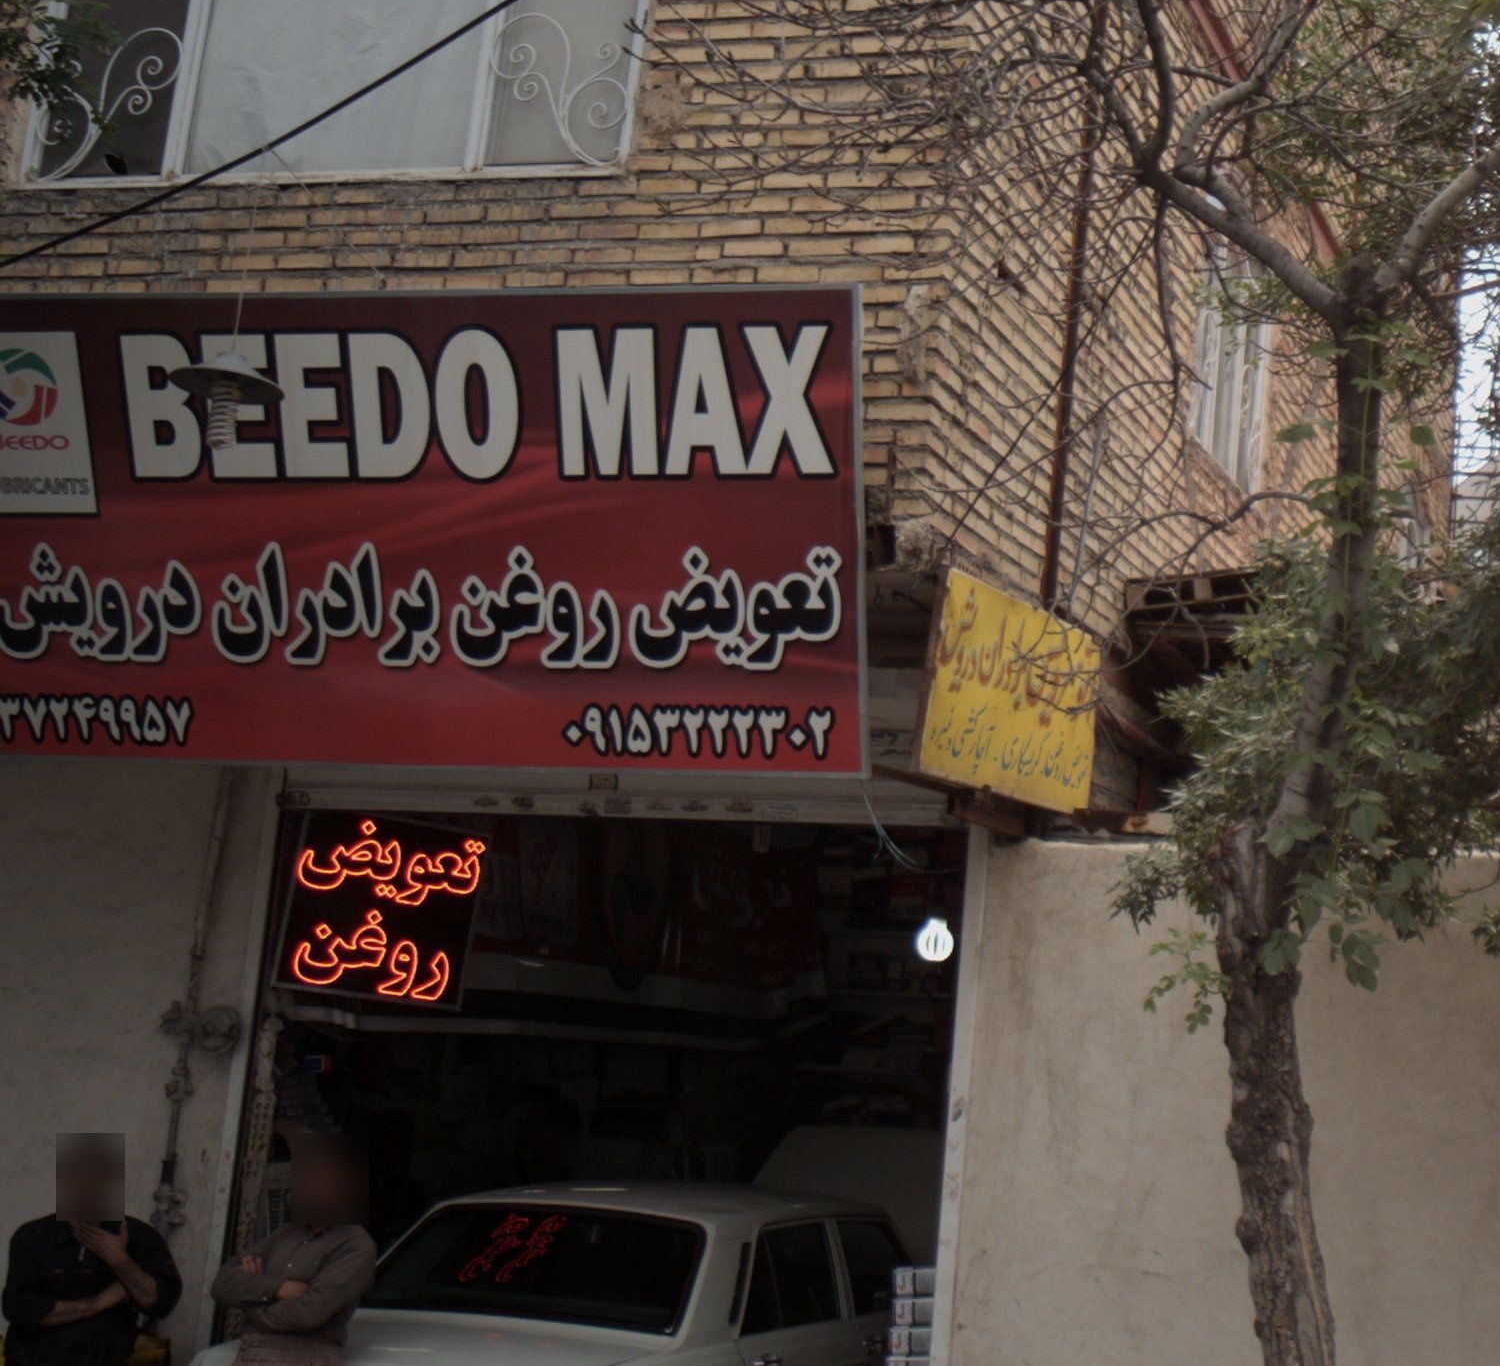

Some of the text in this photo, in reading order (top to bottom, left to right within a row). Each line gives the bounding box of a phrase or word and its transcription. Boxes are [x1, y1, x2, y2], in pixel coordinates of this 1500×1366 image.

[118, 323, 838, 482] BEEDO MAX
[0, 477, 90, 495] BRICANTS
[0, 541, 842, 671] تعویض روغن برادران درویش
[562, 703, 835, 761] ۰۹۱۵۳۲۲۲۳۰۲
[298, 819, 487, 906] تعویض
[292, 908, 450, 1001] روغن
